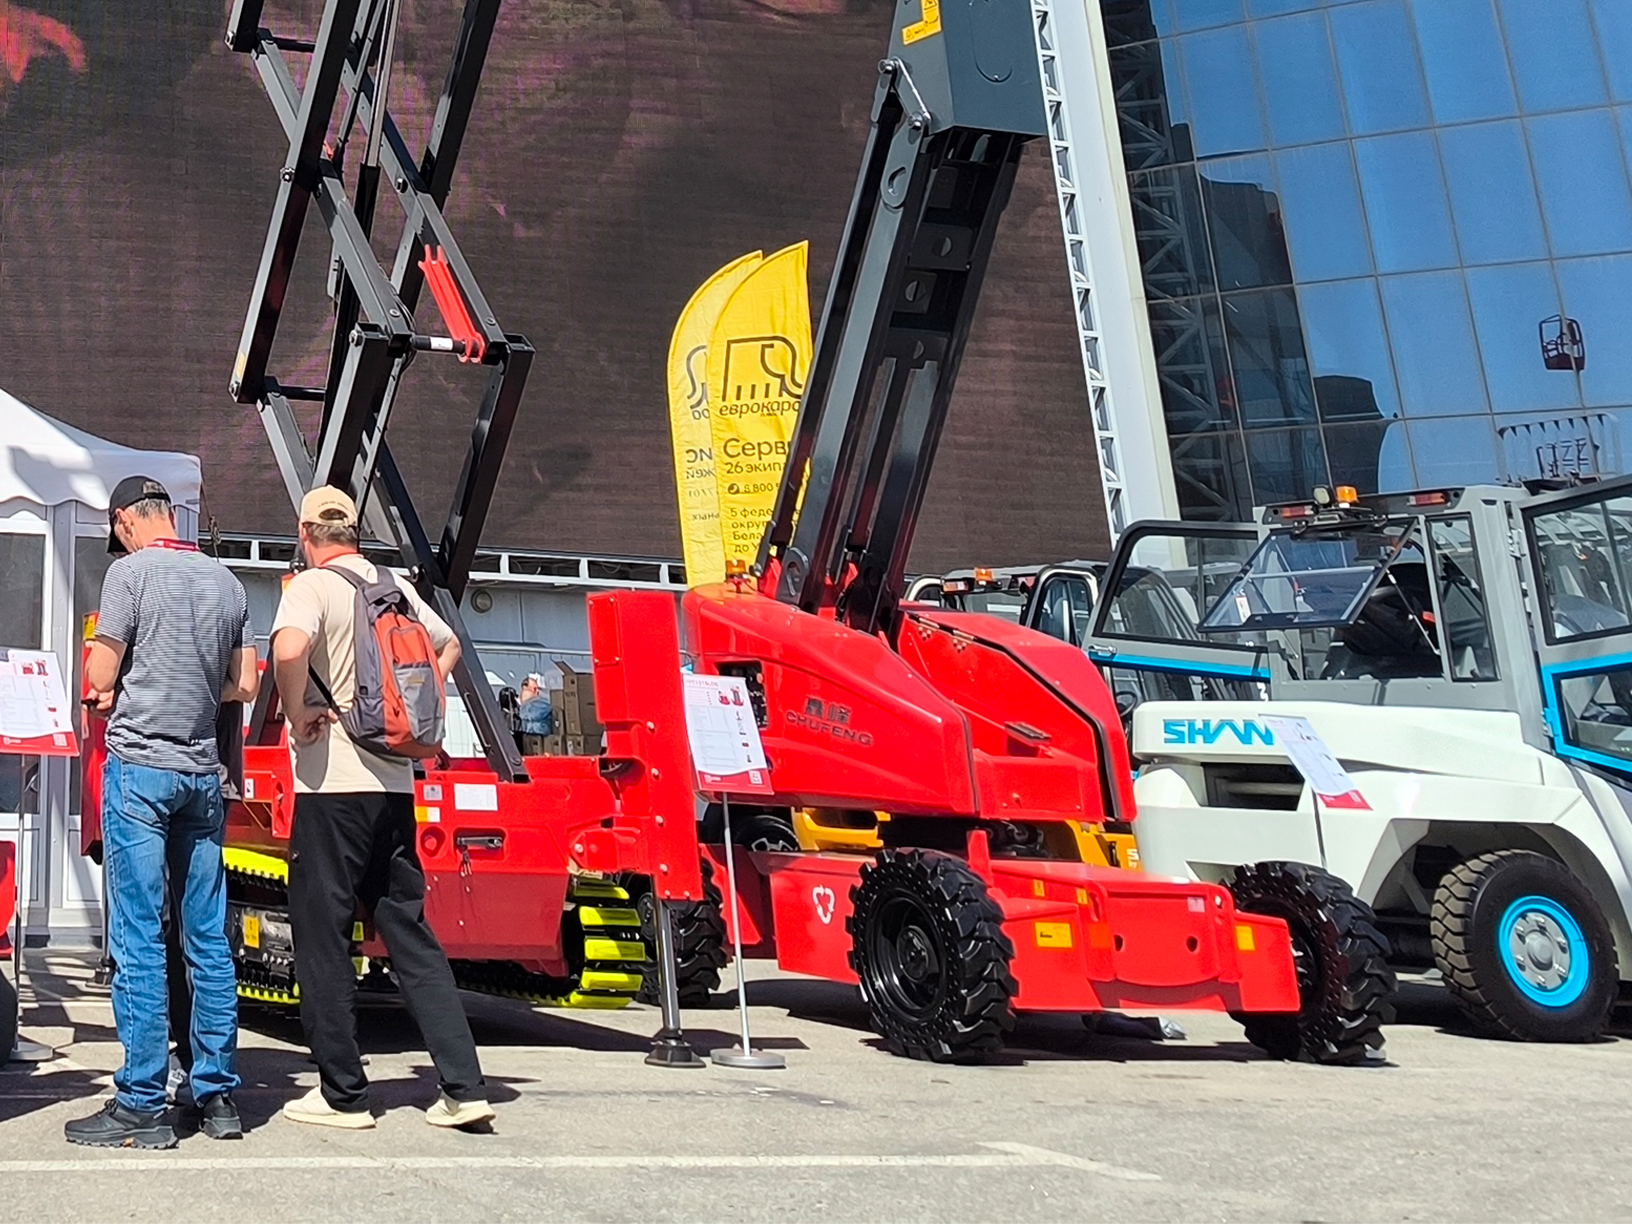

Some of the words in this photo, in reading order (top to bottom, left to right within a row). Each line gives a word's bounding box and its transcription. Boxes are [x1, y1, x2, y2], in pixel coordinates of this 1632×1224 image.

[725, 462, 744, 474] 26
[745, 462, 786, 474] экип
[786, 710, 874, 746] CHUFENG
